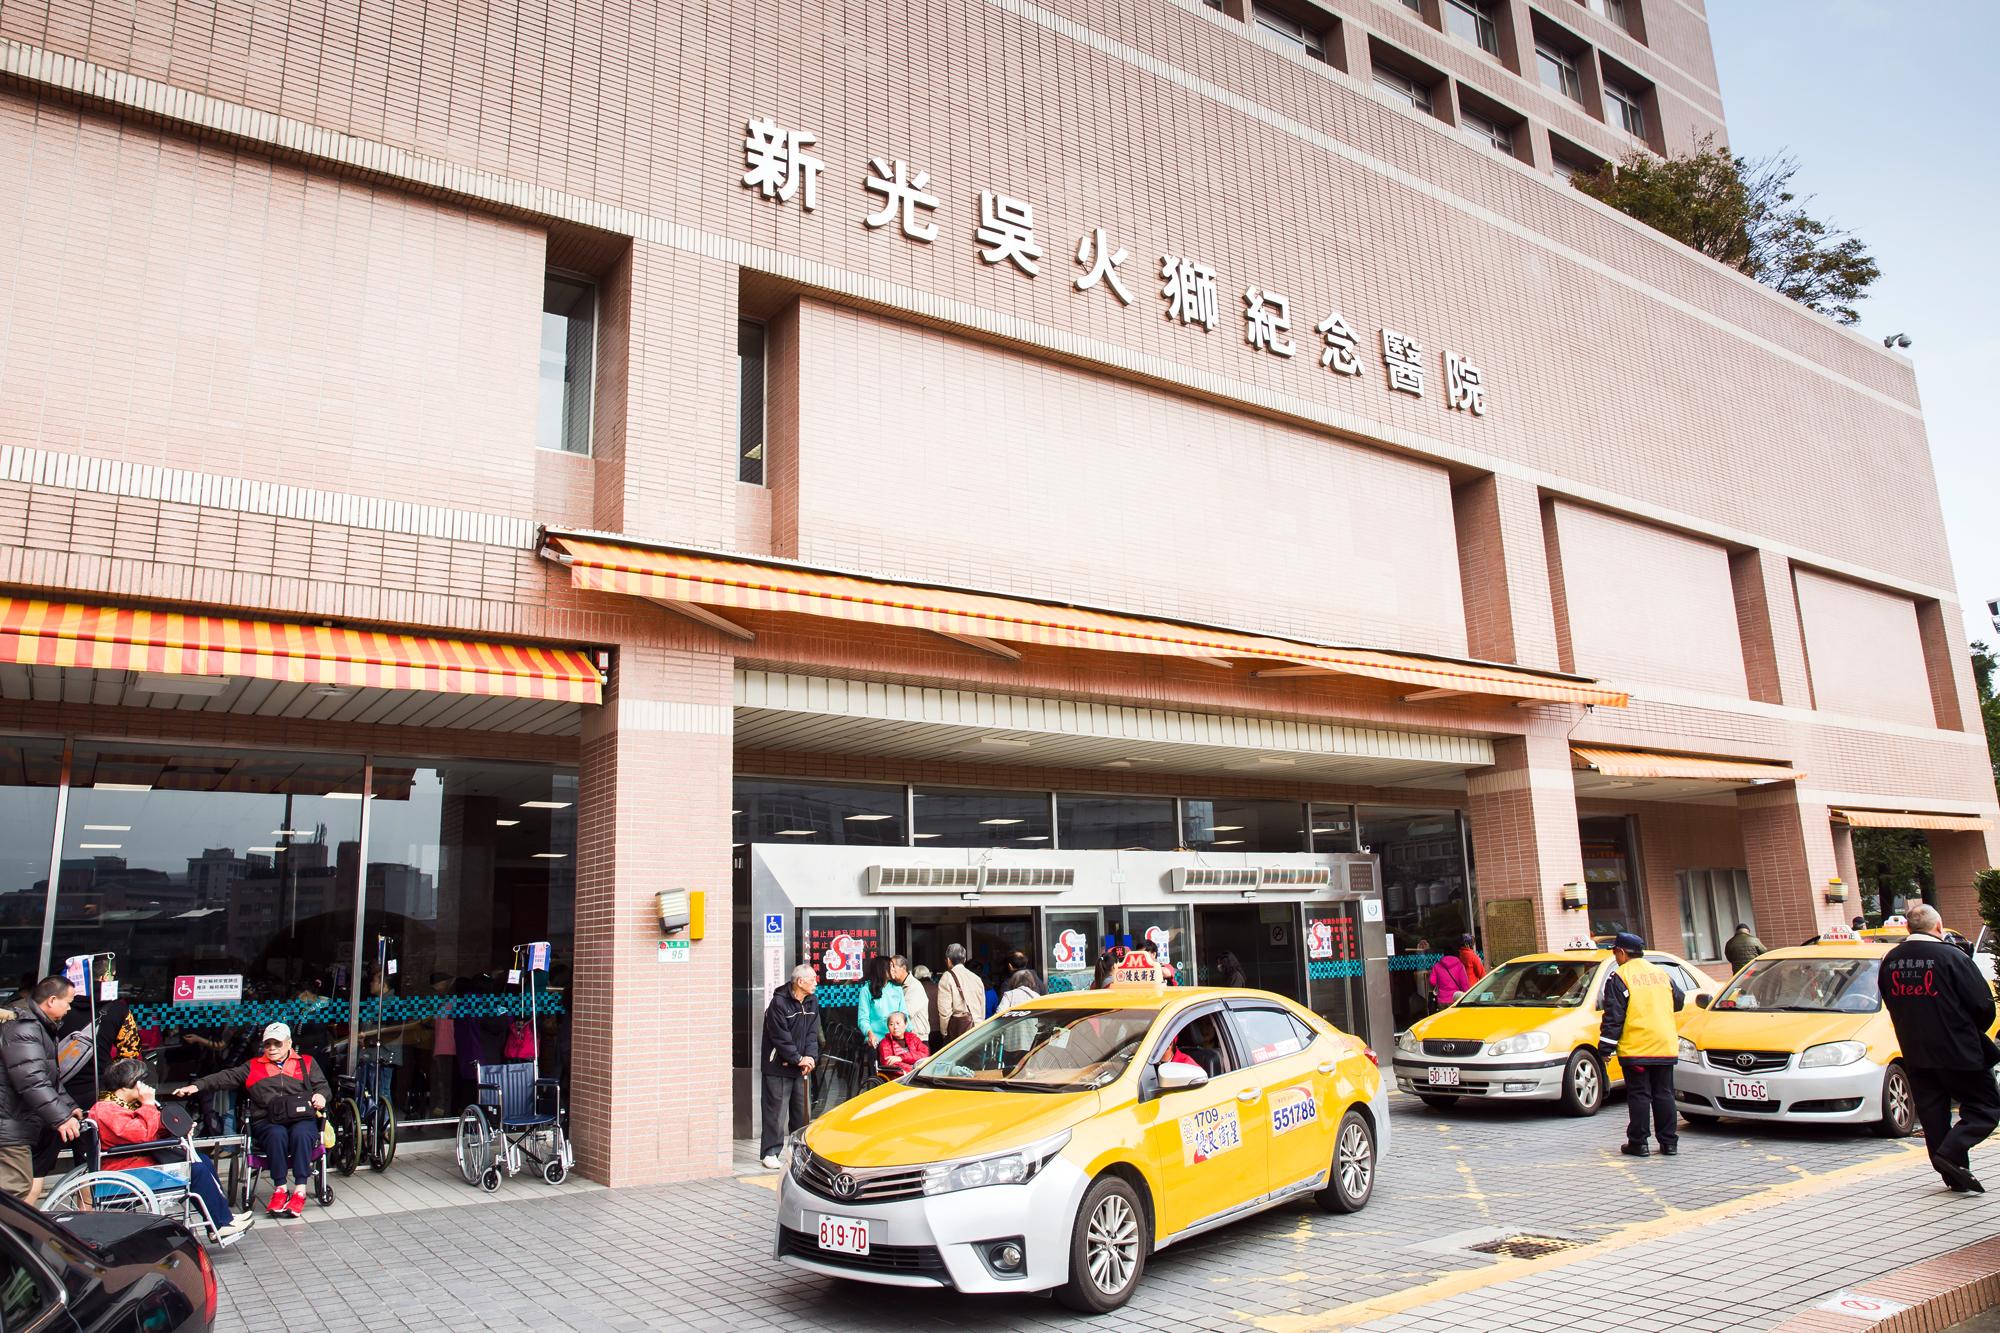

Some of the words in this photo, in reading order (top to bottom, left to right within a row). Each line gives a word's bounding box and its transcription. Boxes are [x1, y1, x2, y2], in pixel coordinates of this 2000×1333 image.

[741, 116, 1487, 416] 新光吳火獅紀念醫院
[1129, 955, 1143, 967] M
[1125, 970, 1156, 982] 優良衛星
[1891, 970, 1938, 997] Steel
[1194, 1108, 1219, 1128] 1709
[1273, 1098, 1316, 1131] 551788
[1195, 1120, 1239, 1155] 優良衛星
[820, 1222, 866, 1249] 819-7D
